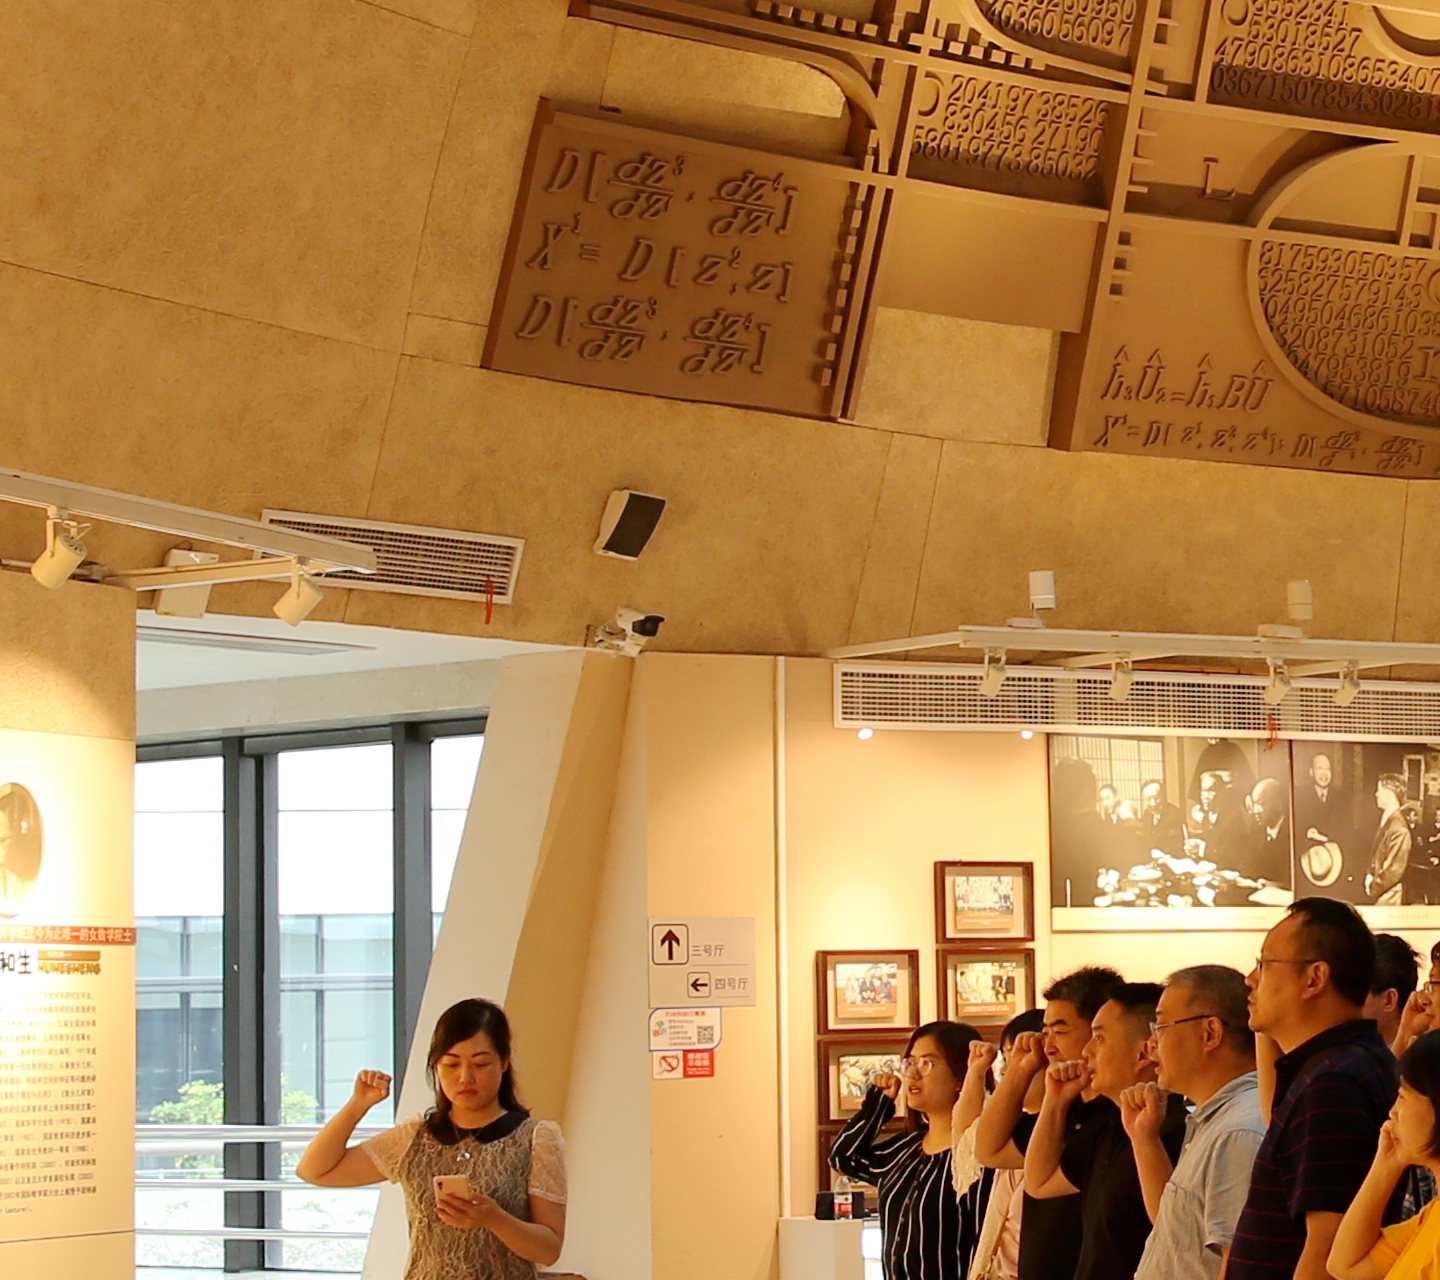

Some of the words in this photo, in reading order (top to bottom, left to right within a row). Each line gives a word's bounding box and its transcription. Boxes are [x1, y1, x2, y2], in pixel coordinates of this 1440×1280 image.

[691, 944, 725, 958] 三号厅
[714, 977, 749, 991] 四号厅
